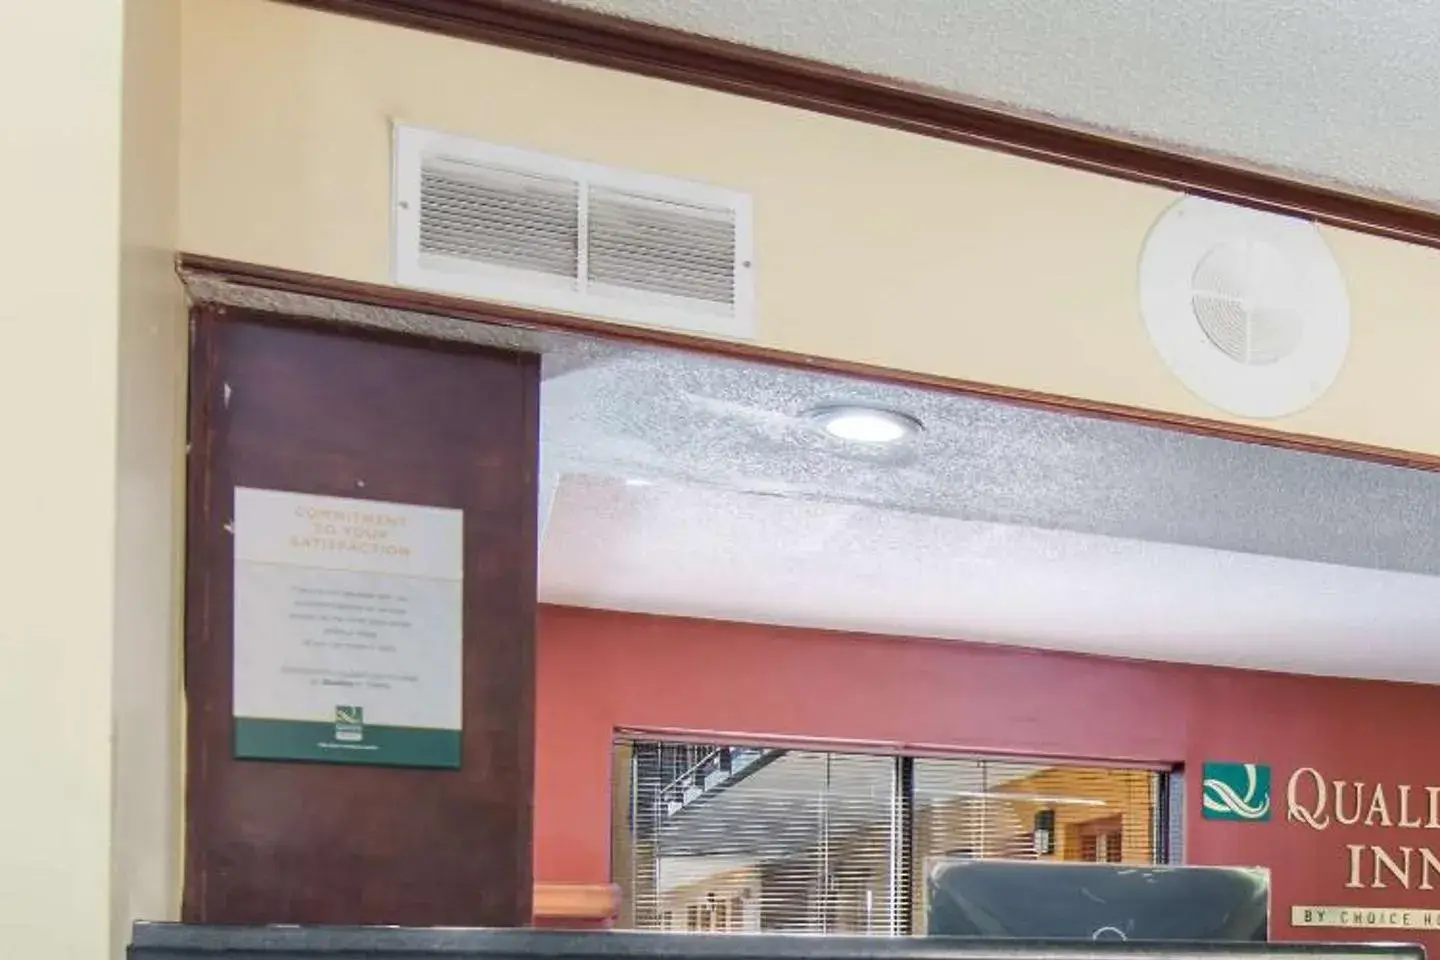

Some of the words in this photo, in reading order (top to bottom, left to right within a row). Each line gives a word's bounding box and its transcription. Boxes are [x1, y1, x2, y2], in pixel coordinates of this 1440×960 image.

[312, 523, 337, 535] TO
[1304, 909, 1326, 923] BY
[1340, 911, 1411, 926] CHOICE
